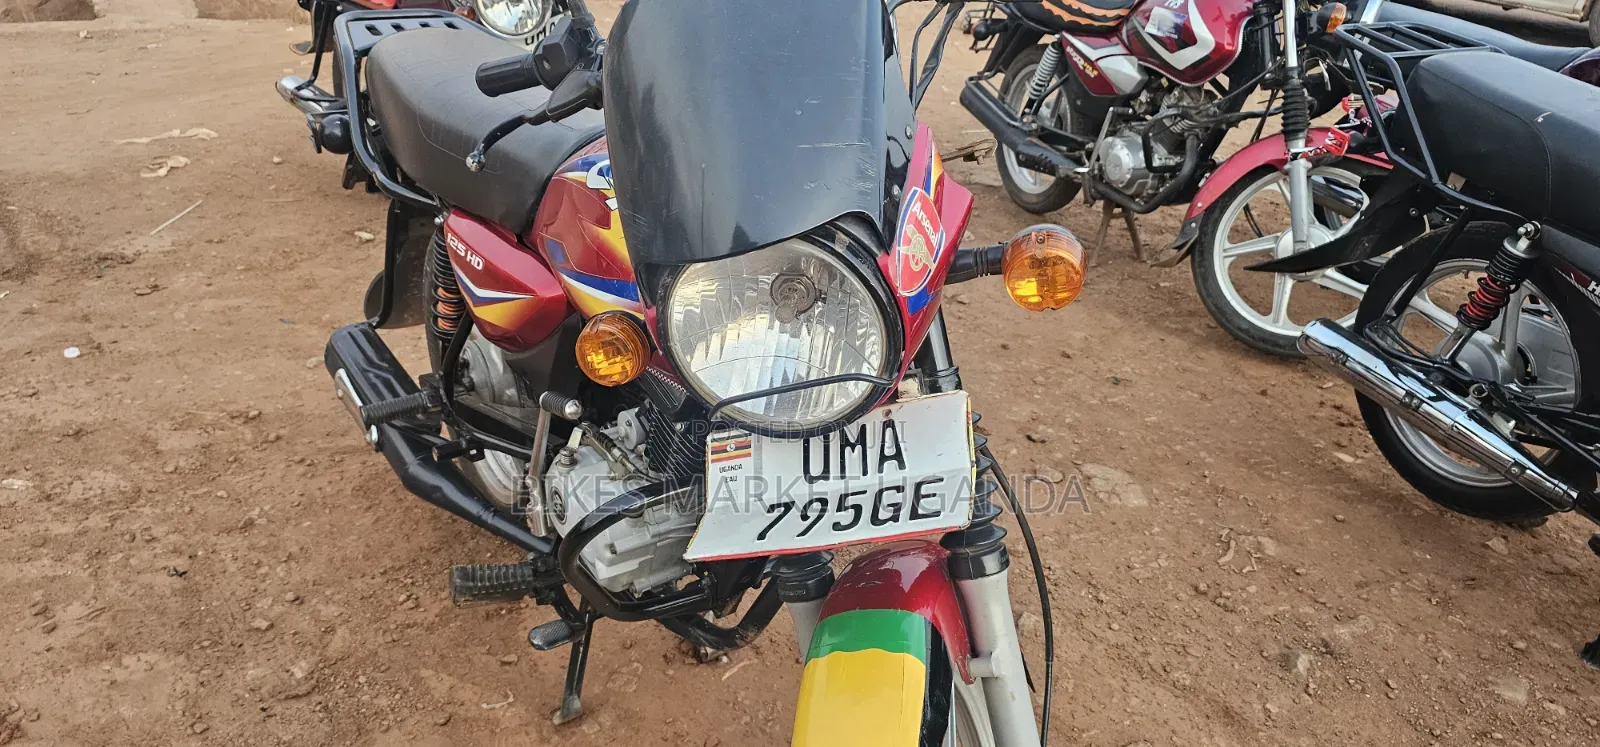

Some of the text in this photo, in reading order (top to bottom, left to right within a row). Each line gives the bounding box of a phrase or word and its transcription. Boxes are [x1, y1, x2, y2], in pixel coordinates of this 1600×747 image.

[912, 201, 940, 248] Arsenal
[447, 232, 484, 271] 125 HD
[719, 463, 743, 474] UGANDA
[802, 418, 907, 484] UMA
[756, 476, 945, 542] 795GE
